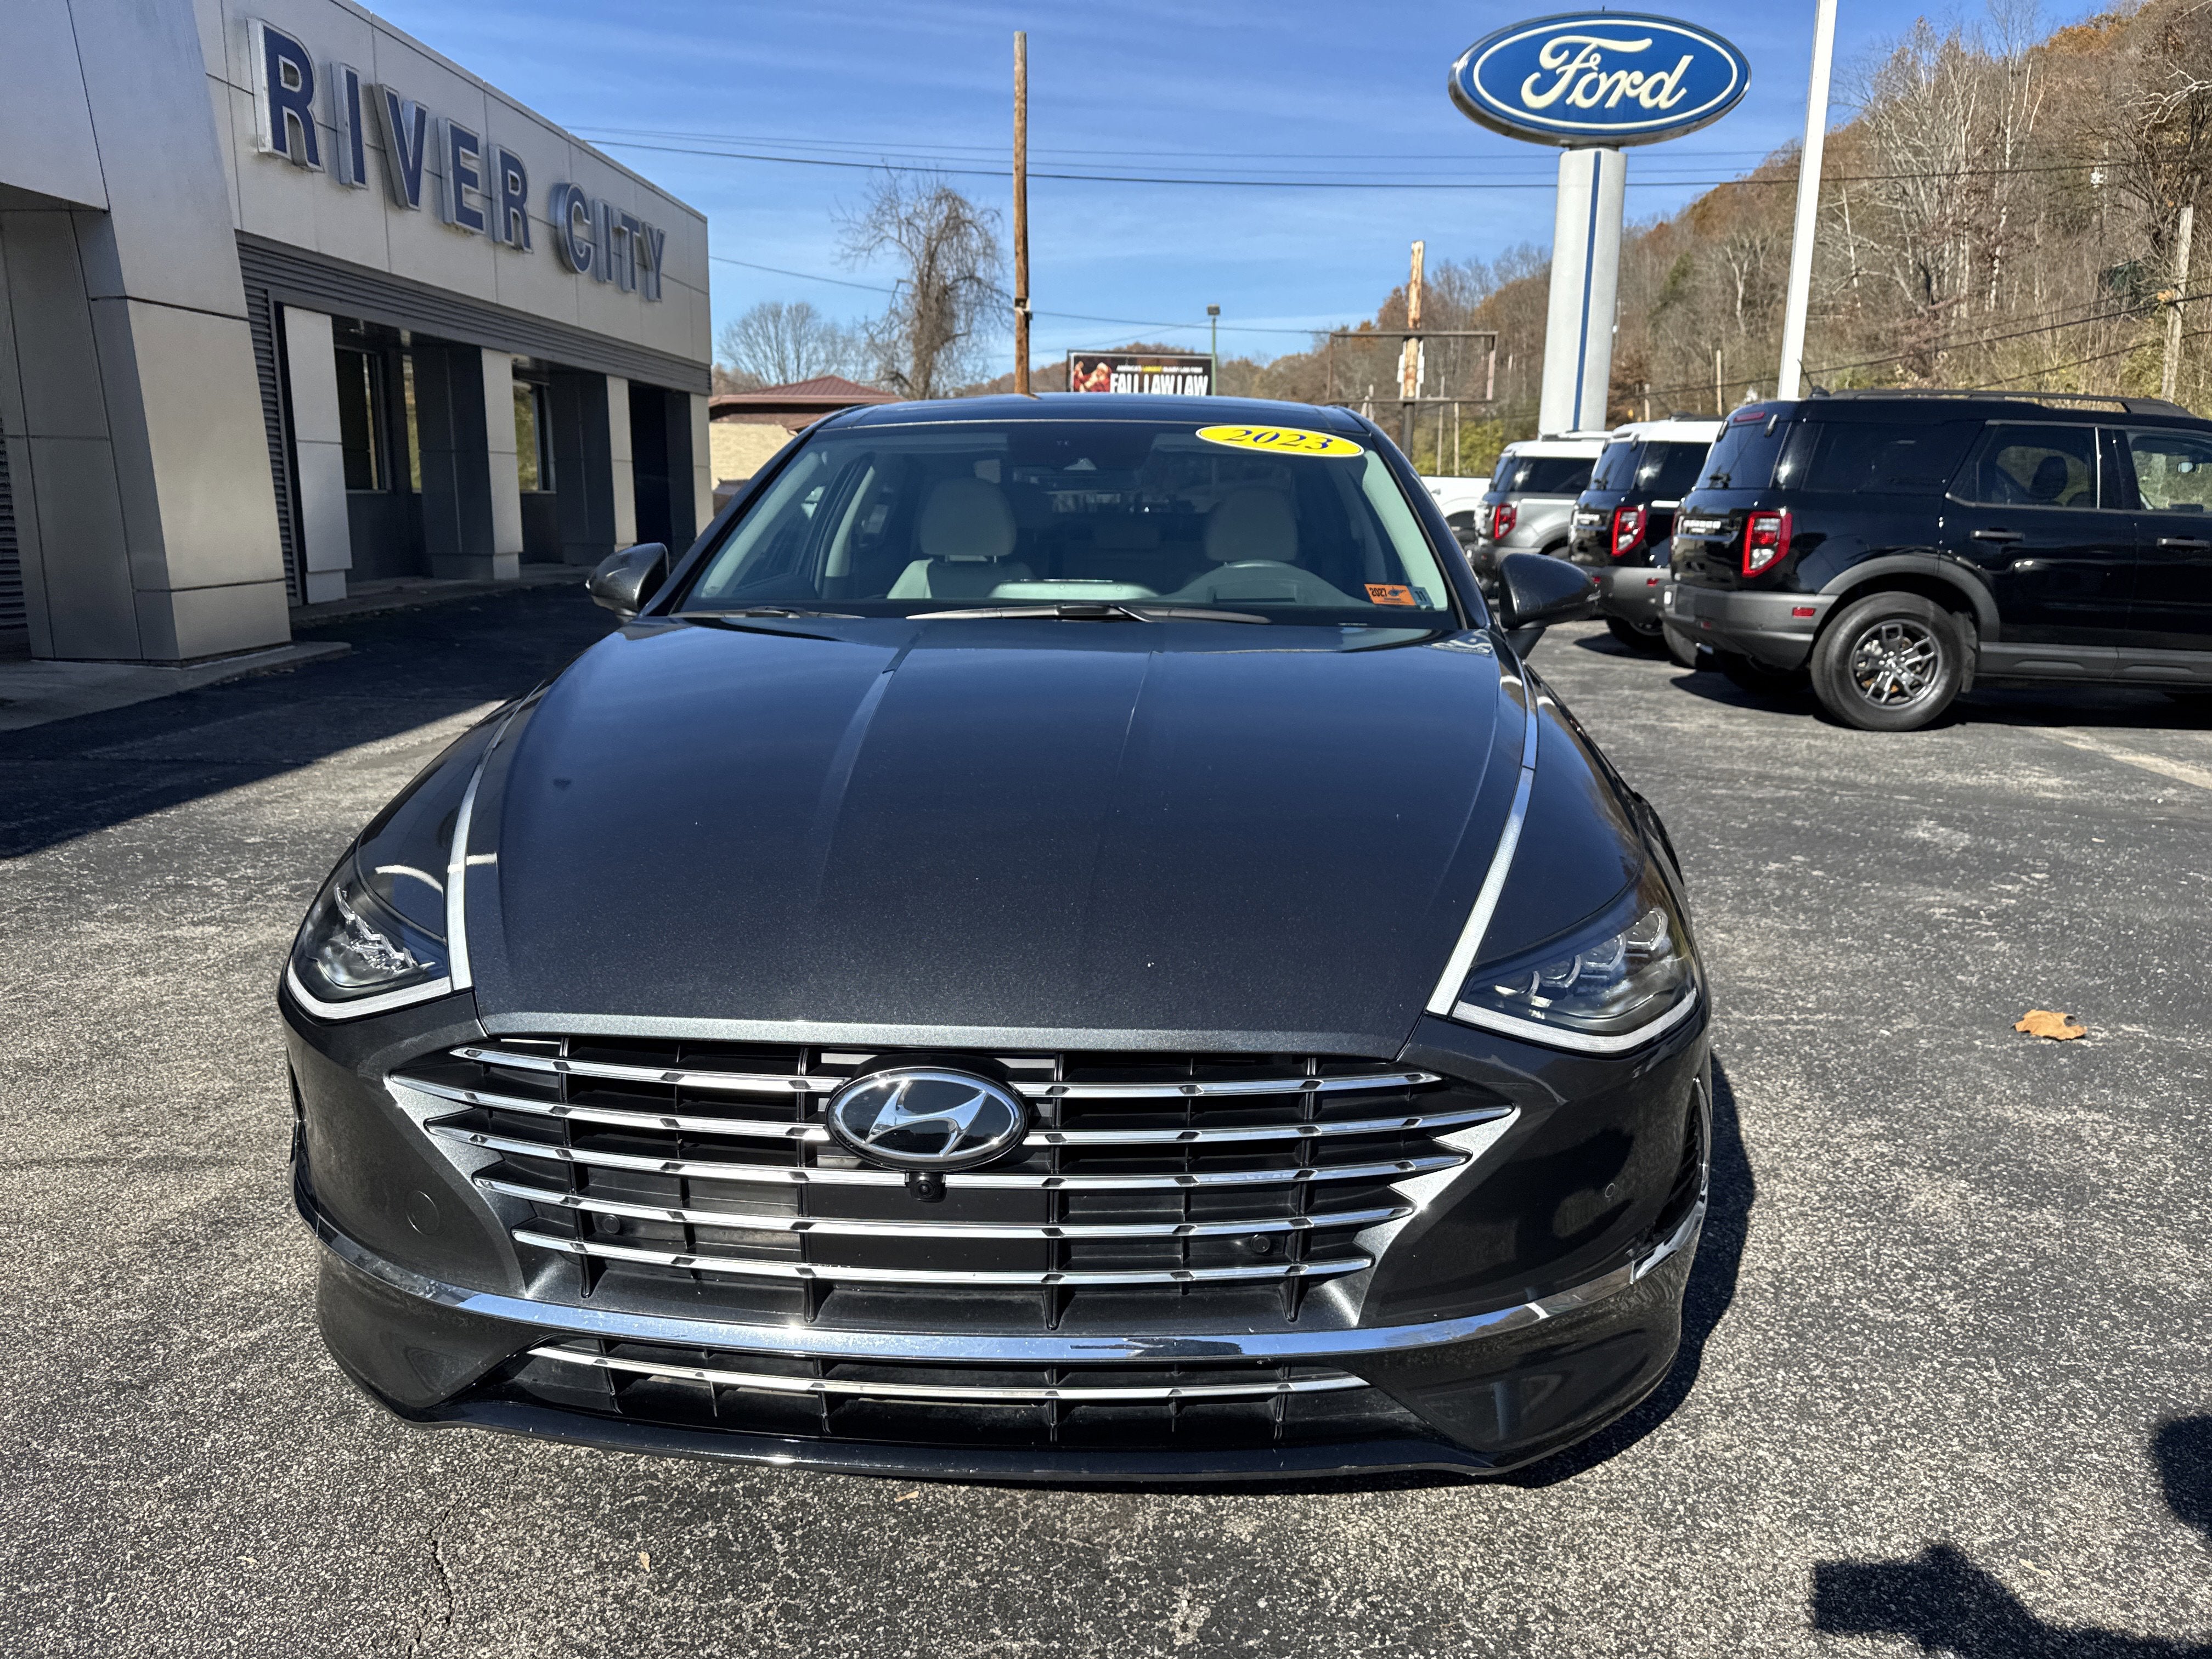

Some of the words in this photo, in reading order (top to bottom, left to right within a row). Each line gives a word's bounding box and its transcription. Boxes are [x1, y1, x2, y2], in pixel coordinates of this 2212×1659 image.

[1520, 35, 1694, 110] Ford
[247, 18, 533, 253] RIVER
[554, 183, 666, 302] CITY
[1223, 429, 1334, 449] 2023
[1369, 587, 1387, 597] 2027
